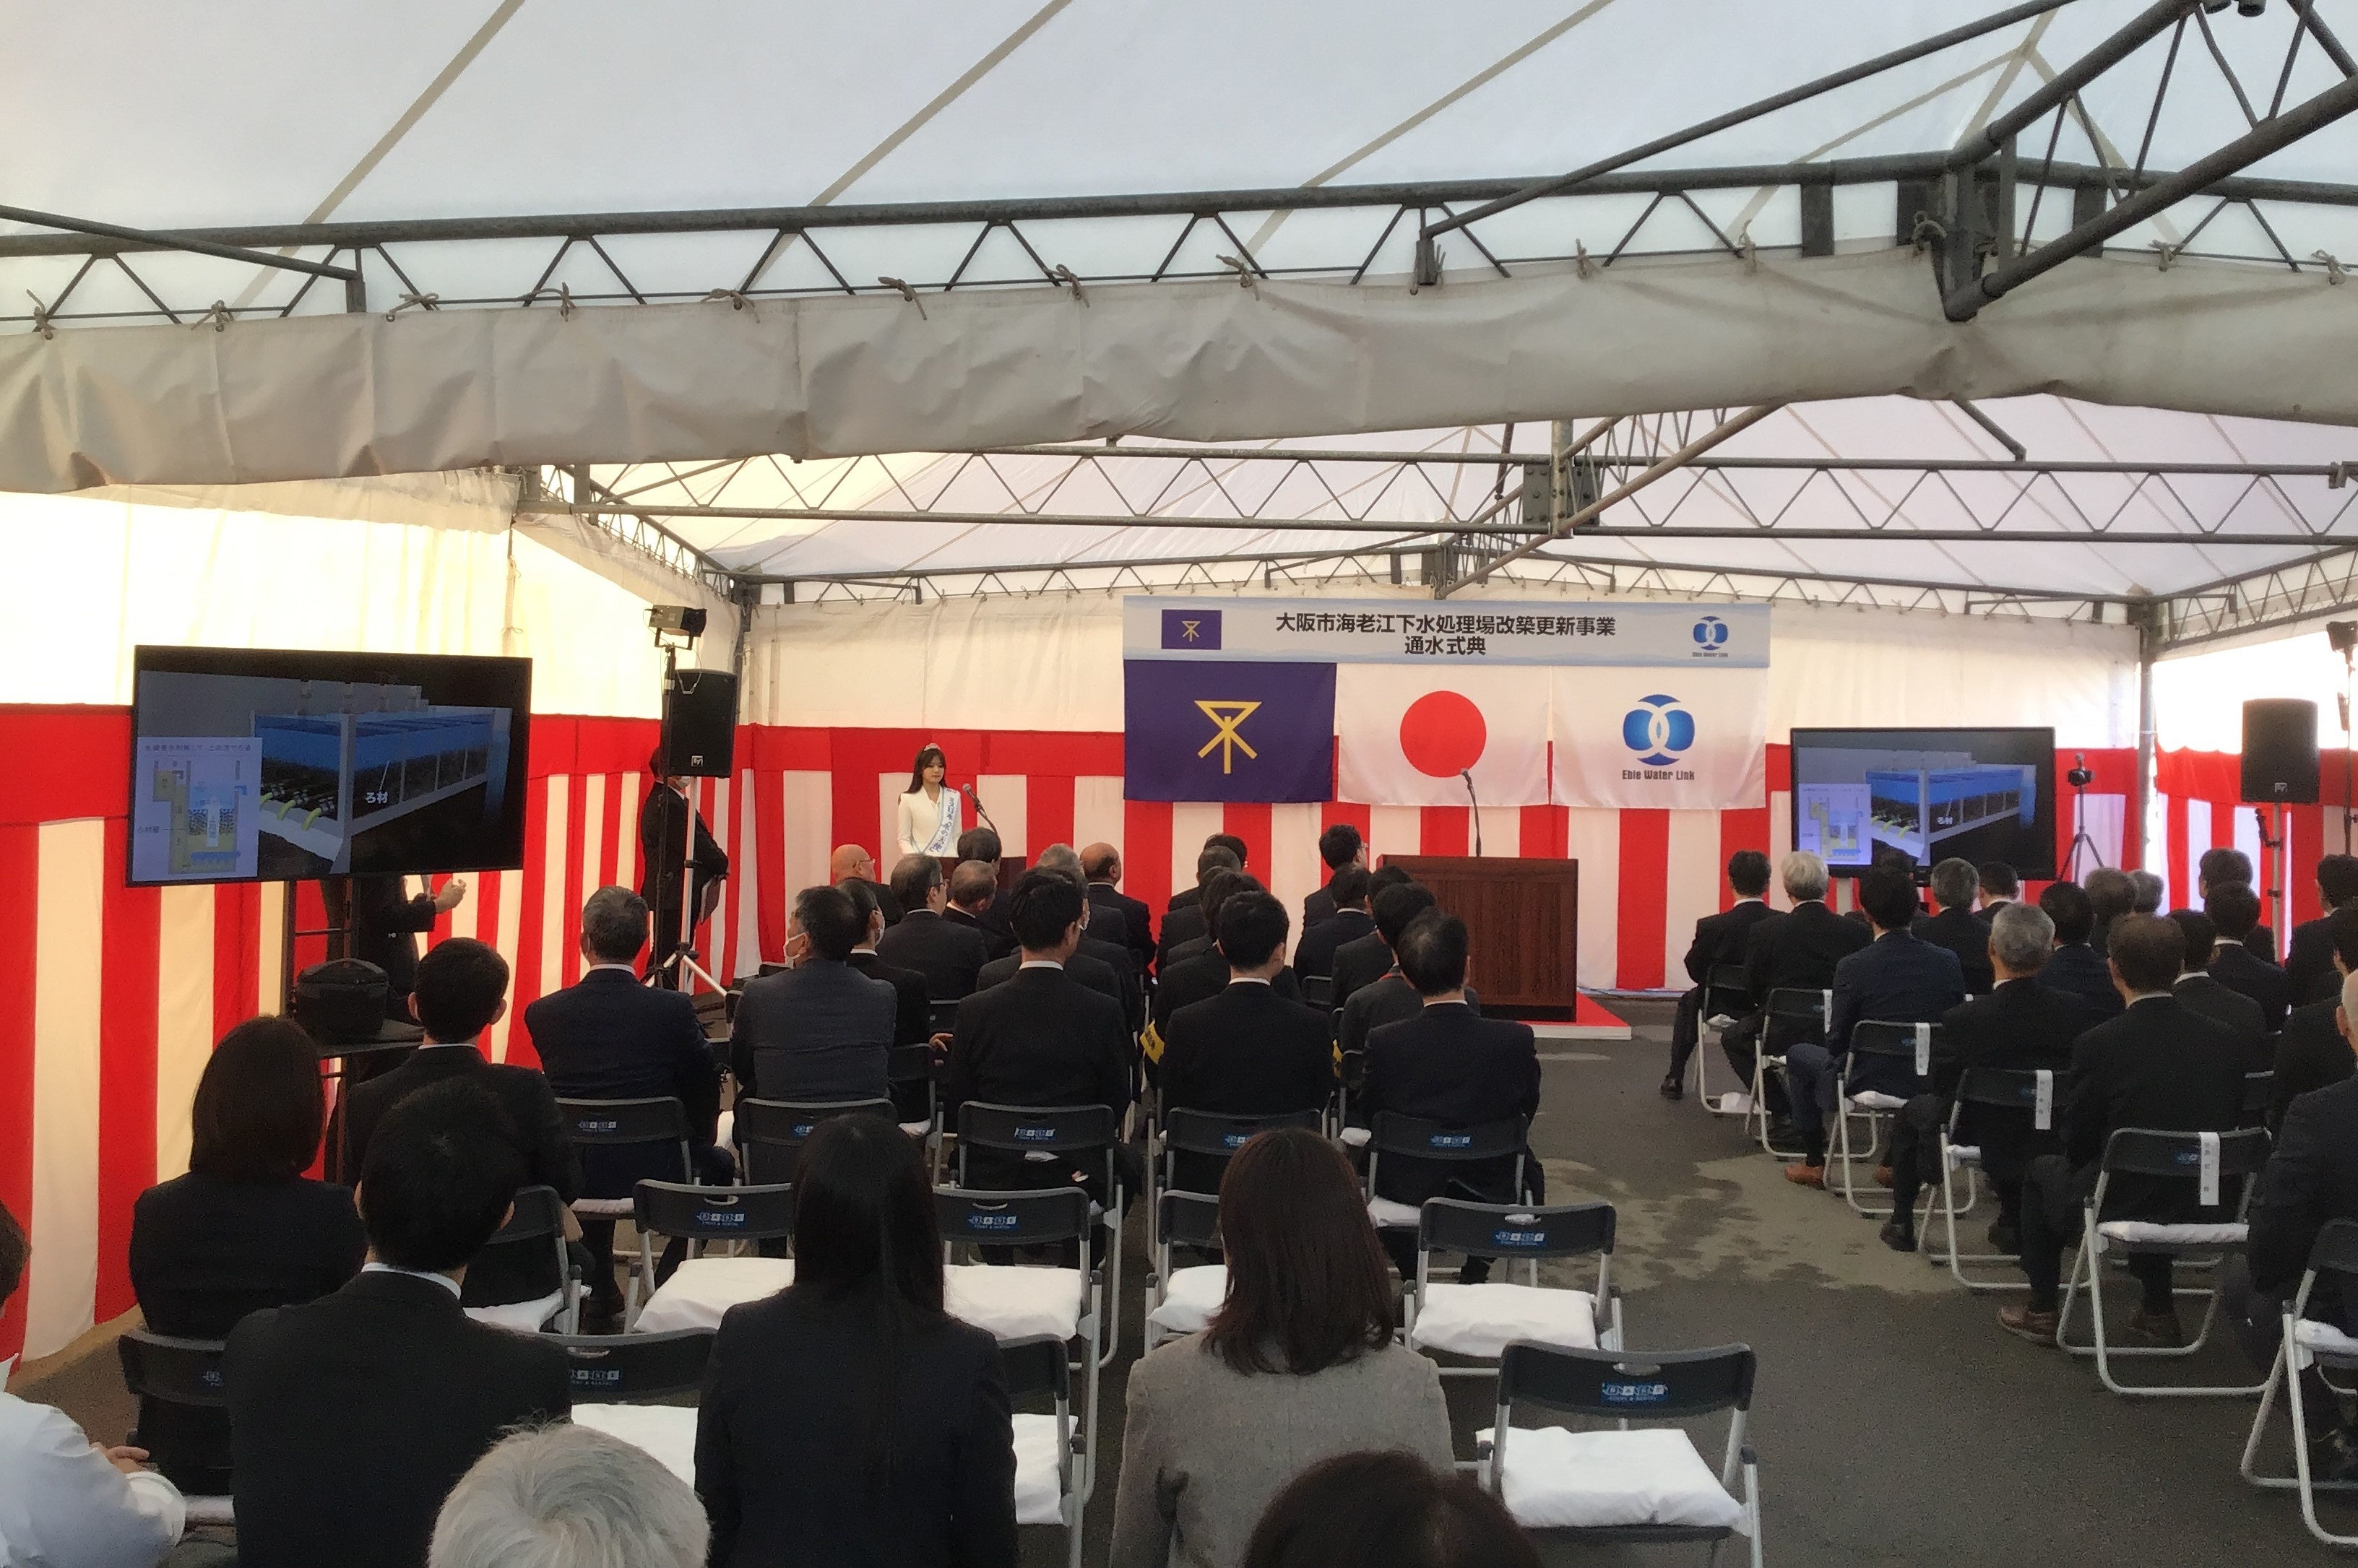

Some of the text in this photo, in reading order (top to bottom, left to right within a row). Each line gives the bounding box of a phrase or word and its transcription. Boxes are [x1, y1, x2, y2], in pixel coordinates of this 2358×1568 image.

[1276, 612, 1616, 636] 大阪市海老江下水処理場改築更新事業
[1404, 635, 1487, 655] 通水式典
[1622, 769, 1695, 781] Ebie Water Link
[365, 791, 389, 804] ろ材
